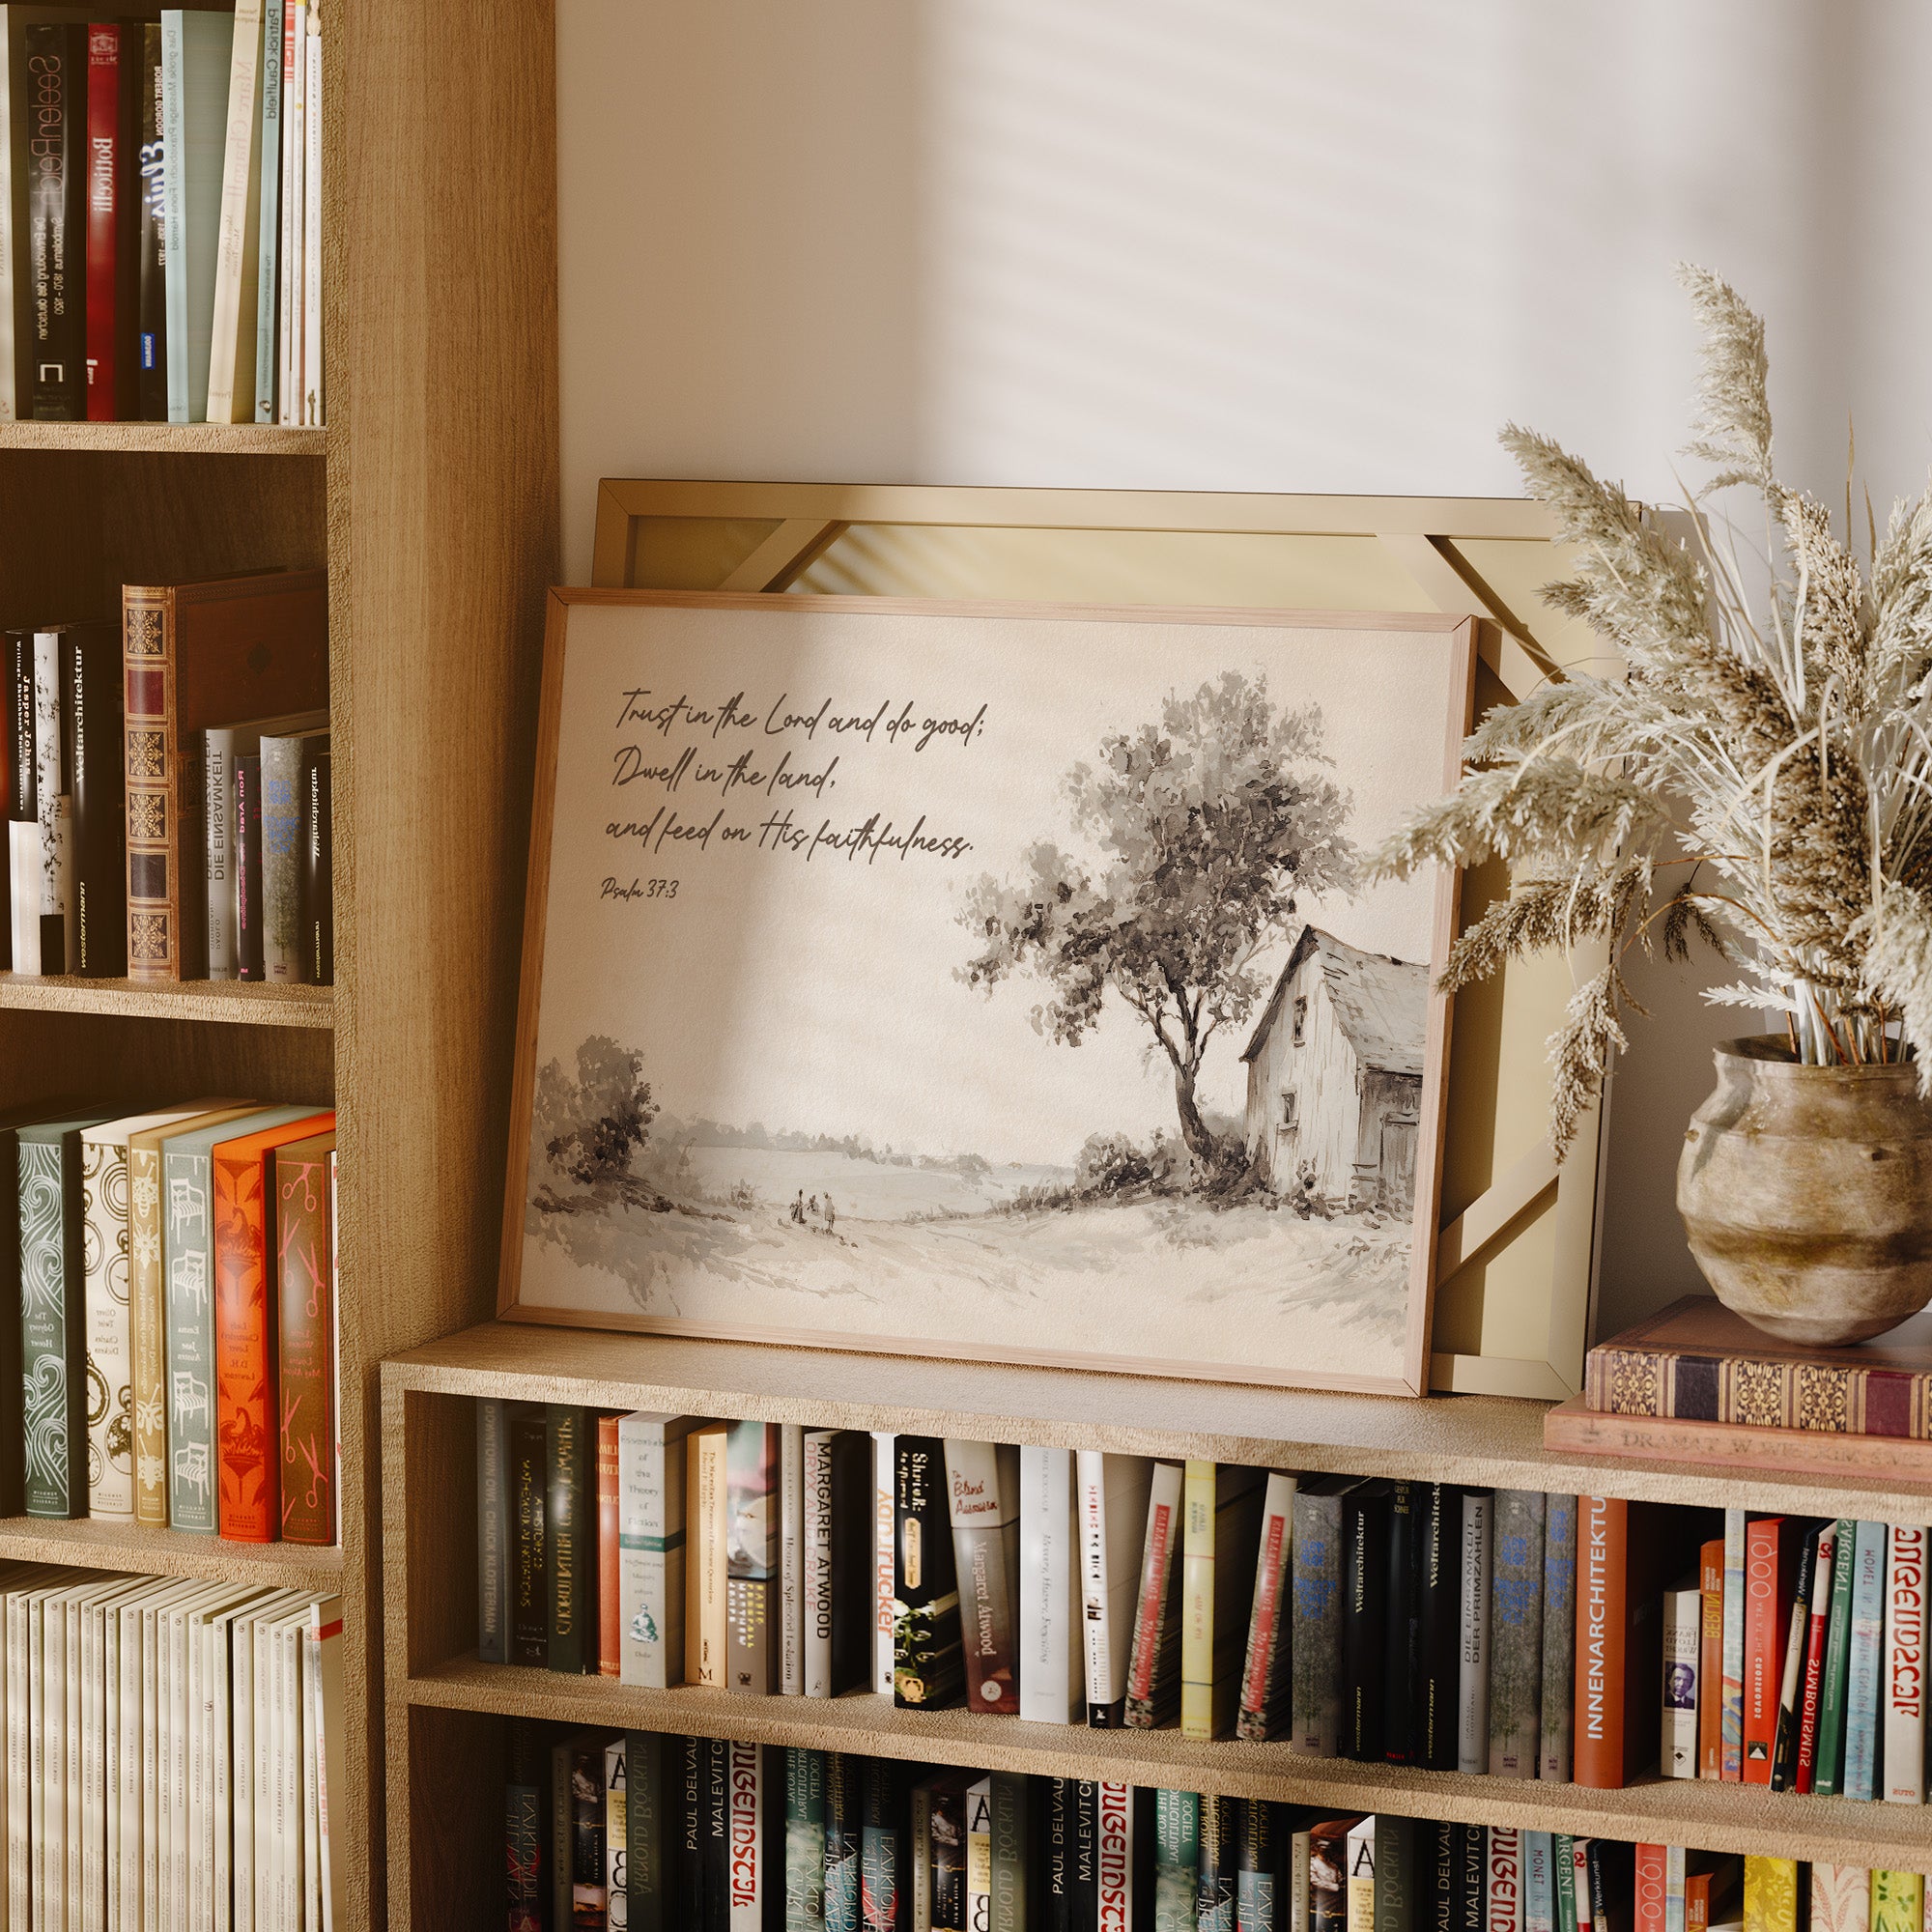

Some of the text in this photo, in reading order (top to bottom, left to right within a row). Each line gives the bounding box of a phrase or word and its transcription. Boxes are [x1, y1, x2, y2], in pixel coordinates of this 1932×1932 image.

[22, 675, 32, 776] Jasper Johns
[72, 645, 85, 784] Weltarchitektur
[616, 687, 988, 753] Trust in the Lord and do good;
[611, 745, 840, 799] Dwell in the land,
[600, 877, 680, 901] Psalm 37:3
[605, 807, 975, 866] and feed on His faithfulness.
[484, 1405, 497, 1634] DOWNTOWN OWL CHUCK KLOSTERMAN
[806, 1441, 817, 1613] ORYX AND CRAKE
[816, 1441, 832, 1640] MARGARET ATWOOD
[1354, 1510, 1365, 1614] Weltarchitektur
[972, 1541, 998, 1657] Margaret Atwood
[1464, 1521, 1473, 1630] EINSAMKEIT
[1472, 1506, 1484, 1663] DER PRIMZAHLEN
[1586, 1496, 1605, 1740] INNENARCHITEKTU
[697, 1667, 712, 1681] M
[685, 1736, 697, 1852] PAUL DELVAU
[1051, 1776, 1065, 1894] PAUL DELVAU
[1436, 1821, 1450, 1932] AUL DELVAU
[1532, 1849, 1545, 1886] MONET
[1591, 1860, 1605, 1908] Werkkunst
[1635, 1855, 1662, 1920] 1900
